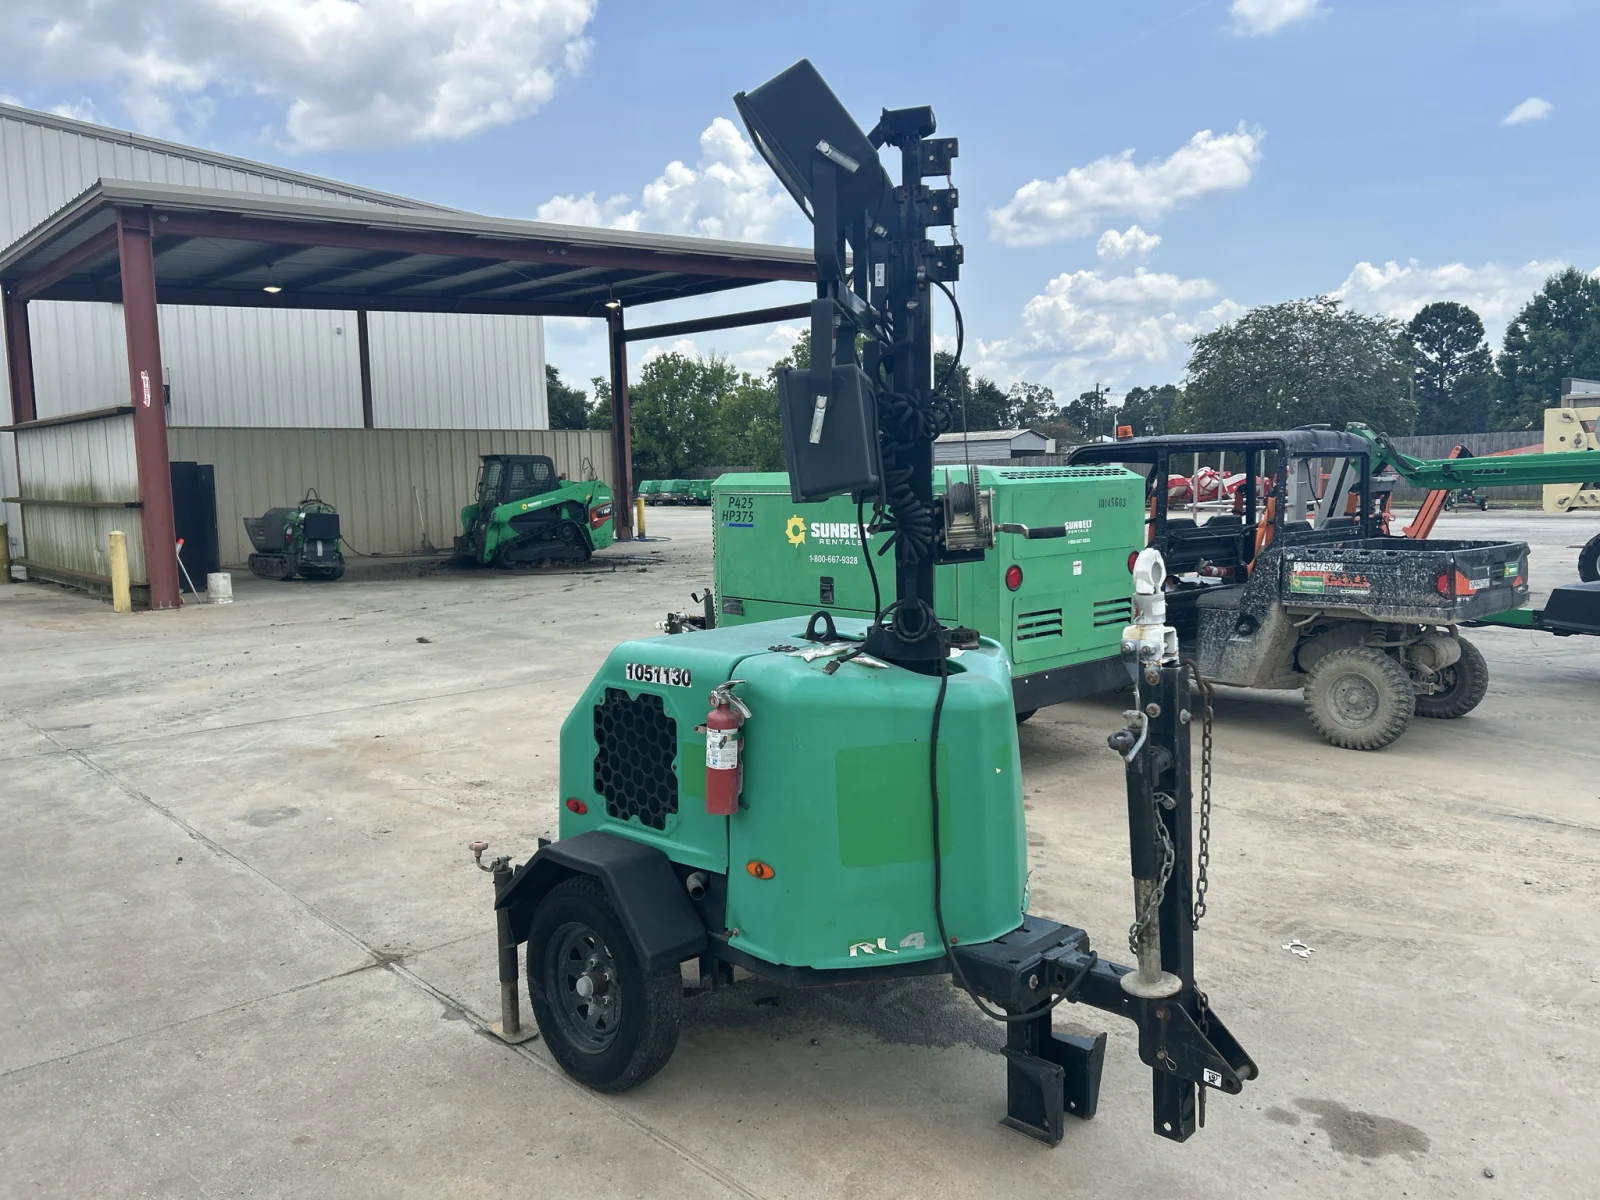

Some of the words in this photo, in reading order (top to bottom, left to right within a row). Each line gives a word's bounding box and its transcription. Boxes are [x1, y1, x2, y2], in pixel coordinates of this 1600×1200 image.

[728, 496, 754, 509] P425
[721, 510, 754, 523] HP375
[1064, 519, 1093, 531] SUNBELT
[819, 538, 863, 546] RENTALS
[809, 554, 858, 565] 1-800-667-9328
[626, 662, 692, 688] 1051130
